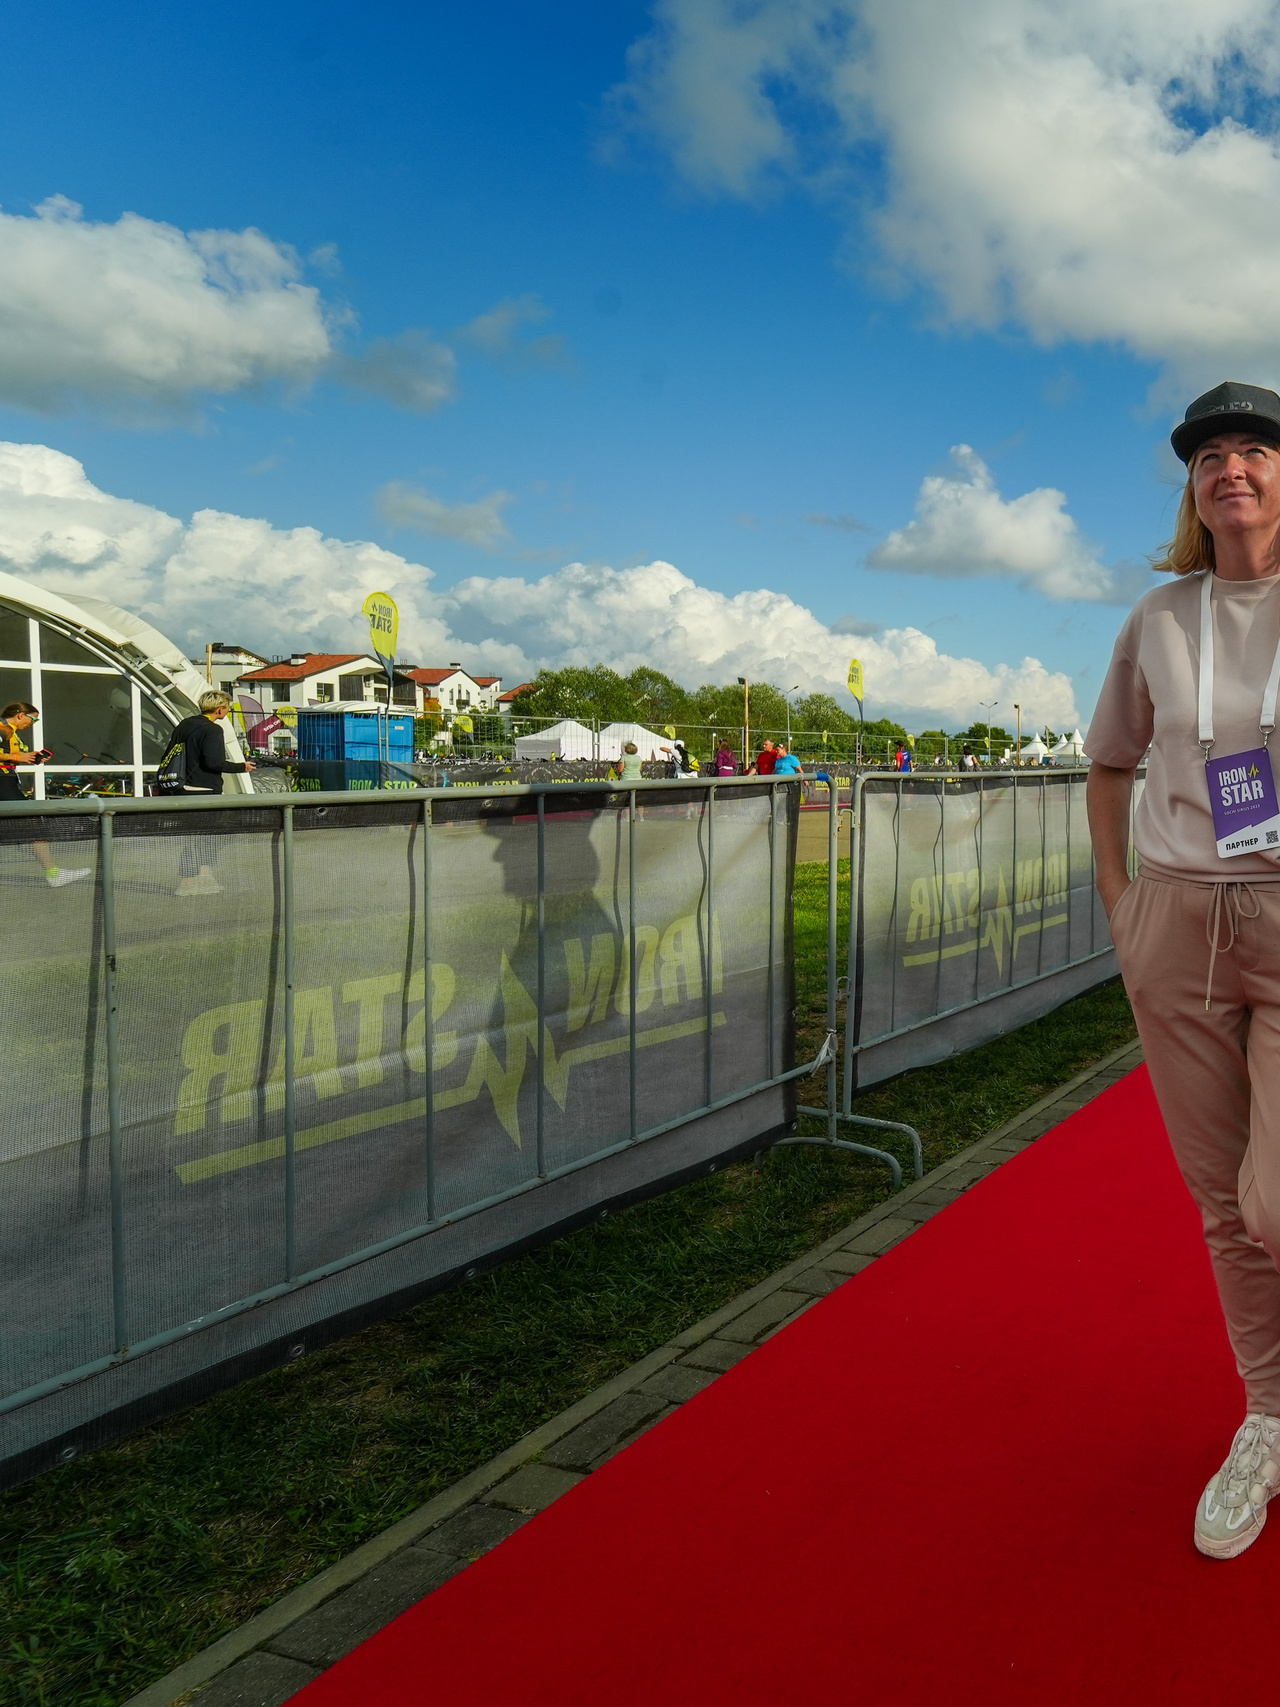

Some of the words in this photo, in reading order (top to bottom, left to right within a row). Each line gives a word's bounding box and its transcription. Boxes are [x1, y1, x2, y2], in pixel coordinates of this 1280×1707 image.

[834, 777, 851, 787] STAR
[1218, 766, 1248, 787] IRON
[300, 778, 321, 791] STAR
[348, 779, 372, 791] IRON
[1221, 779, 1264, 807] STAR
[1225, 837, 1259, 851] ПАРТНЕР
